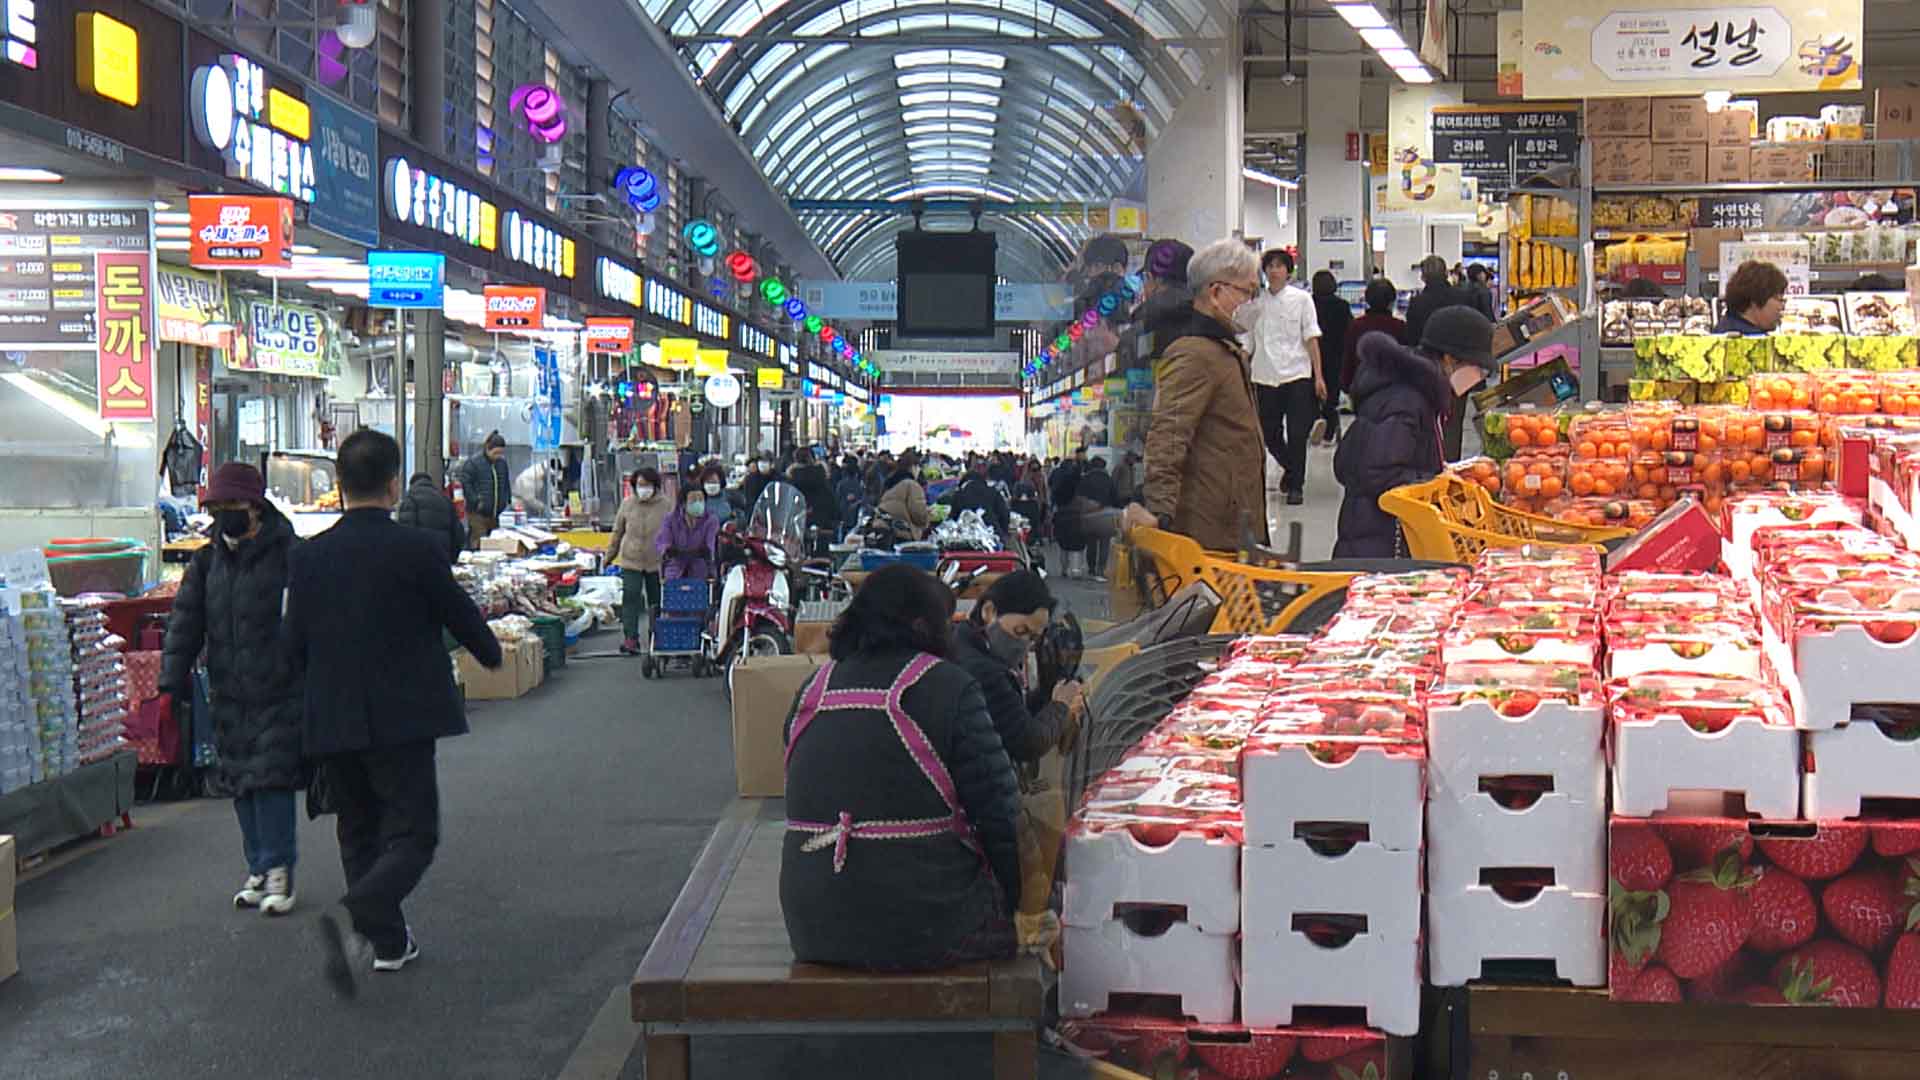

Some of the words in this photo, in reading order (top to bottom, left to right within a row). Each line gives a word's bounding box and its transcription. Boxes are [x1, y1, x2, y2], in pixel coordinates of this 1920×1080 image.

[1679, 17, 1767, 68] 설날
[1517, 114, 1567, 128] 샴푸/린스
[1712, 202, 1762, 217] 자연담은
[103, 264, 149, 410] 돈까스
